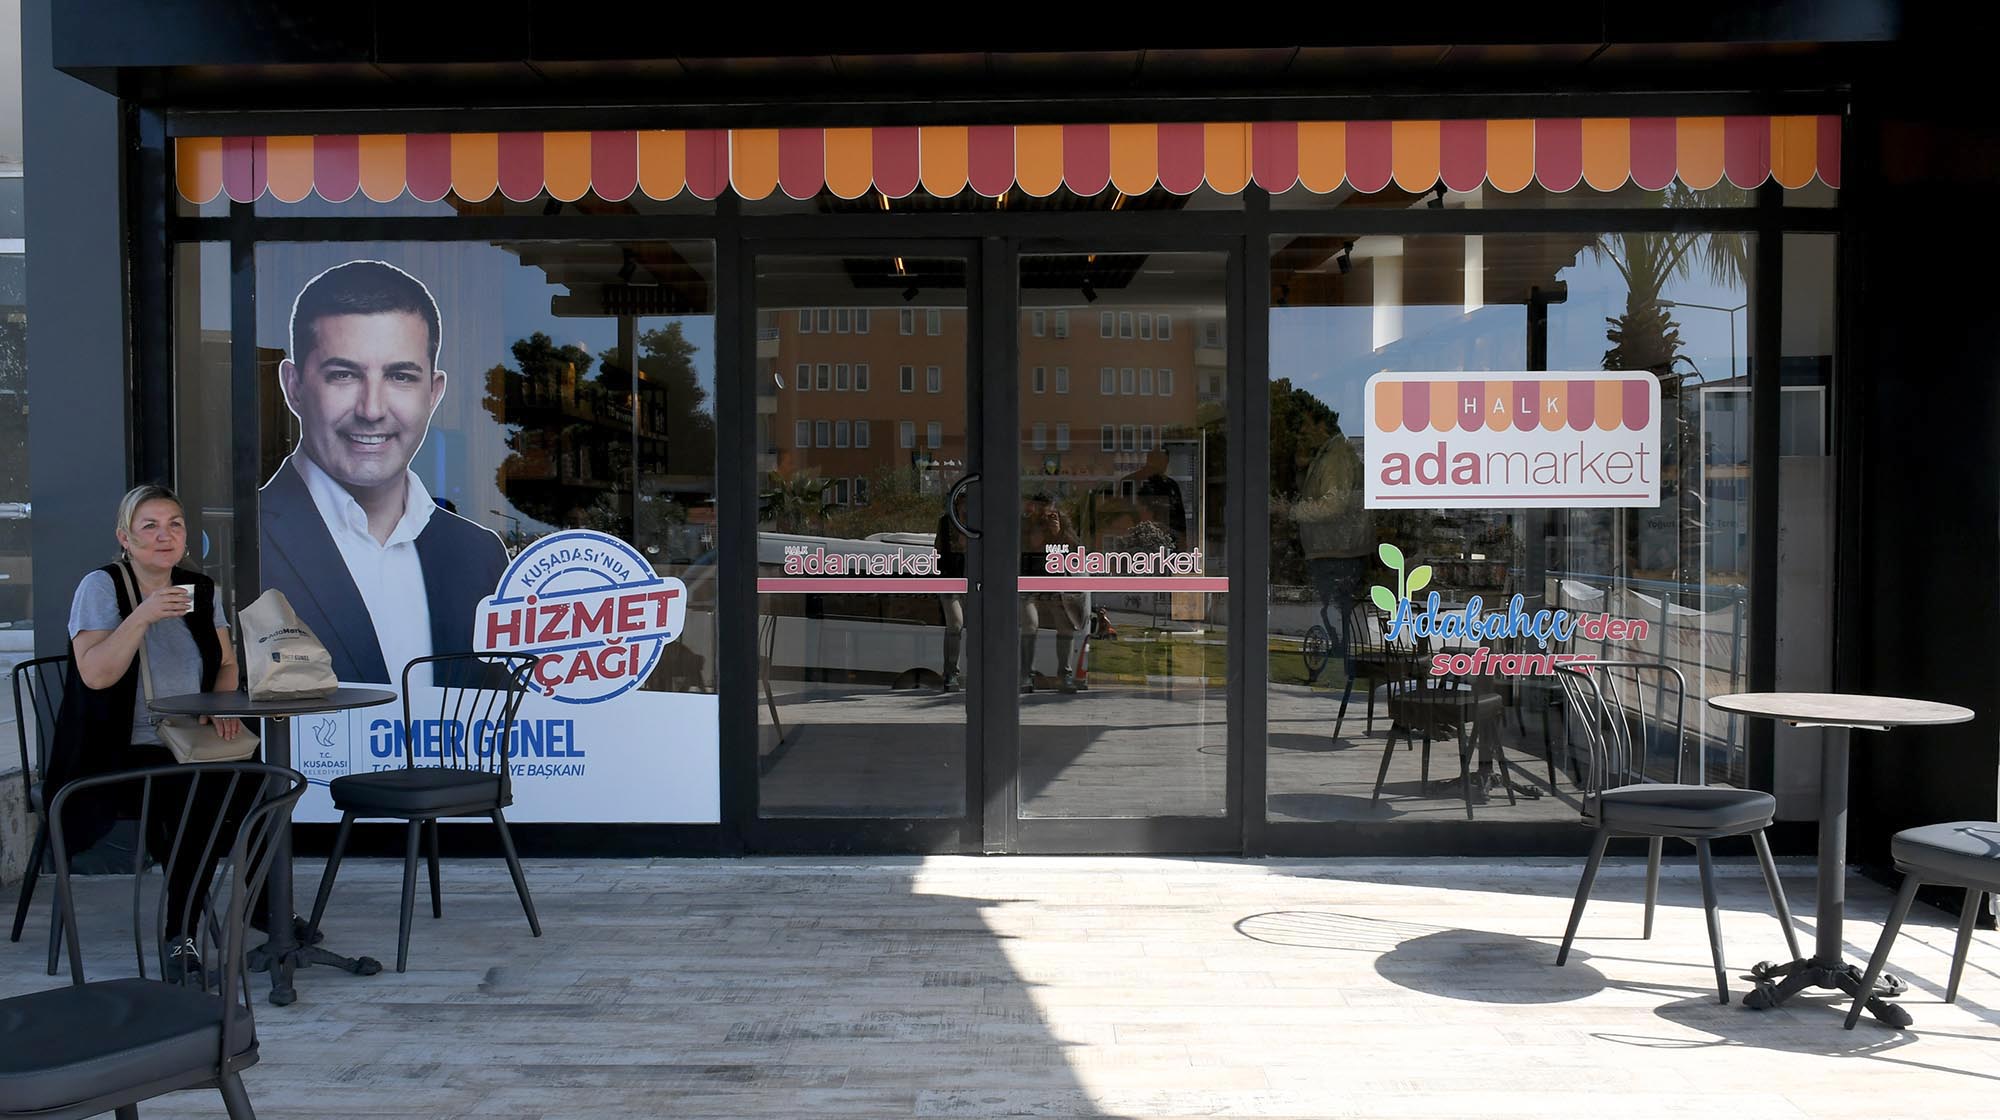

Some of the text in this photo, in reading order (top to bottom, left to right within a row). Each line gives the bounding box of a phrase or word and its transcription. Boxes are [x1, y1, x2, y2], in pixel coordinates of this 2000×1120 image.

[1464, 397, 1559, 414] HALK
[1380, 440, 1650, 486] adamarket
[784, 547, 941, 575] adamarket
[785, 545, 808, 555] HALK
[1045, 546, 1203, 574] adamarket
[1046, 544, 1069, 553] HALK
[486, 589, 679, 649] HİZMET
[534, 636, 640, 697] ÇAĞI
[370, 719, 585, 758] ÖMER GÜNEL
[303, 760, 348, 768] KUŞADASI
[527, 764, 585, 779] BAŞKANI
